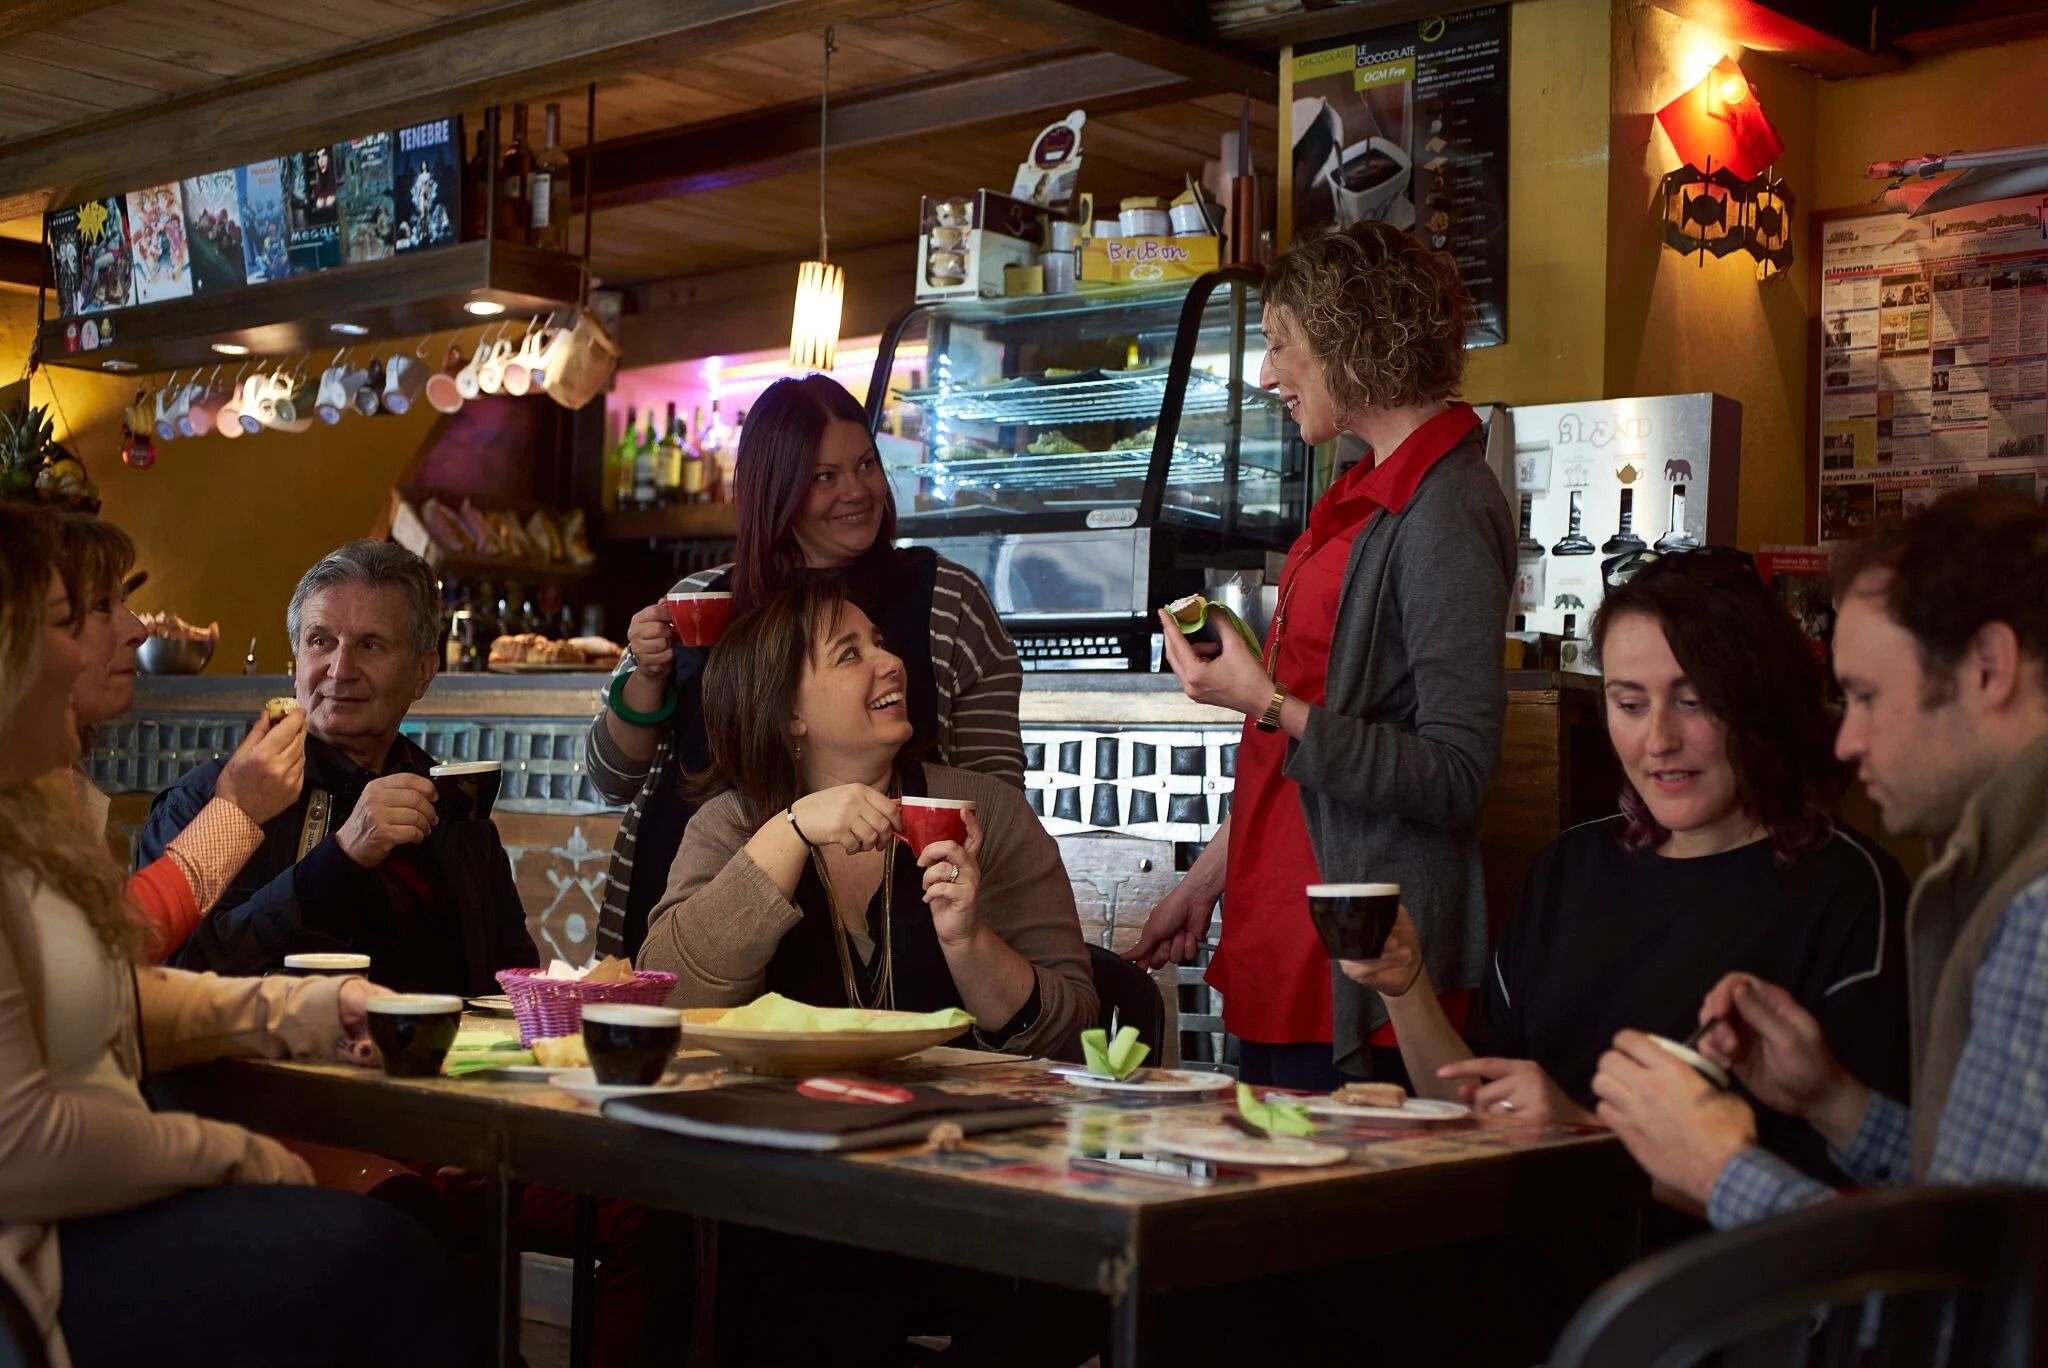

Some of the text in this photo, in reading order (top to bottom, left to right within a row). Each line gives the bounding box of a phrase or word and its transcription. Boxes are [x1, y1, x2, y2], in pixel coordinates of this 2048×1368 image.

[1357, 44, 1367, 56] LE
[1357, 45, 1416, 67] CIOCCOLATE
[1364, 69, 1387, 83] OGM
[399, 119, 450, 151] TENEBRE
[1109, 240, 1190, 263] BriBon
[1824, 263, 1874, 276] cinema
[1558, 413, 1654, 447] BLEND
[1821, 465, 1960, 482] teatro musica eventi
